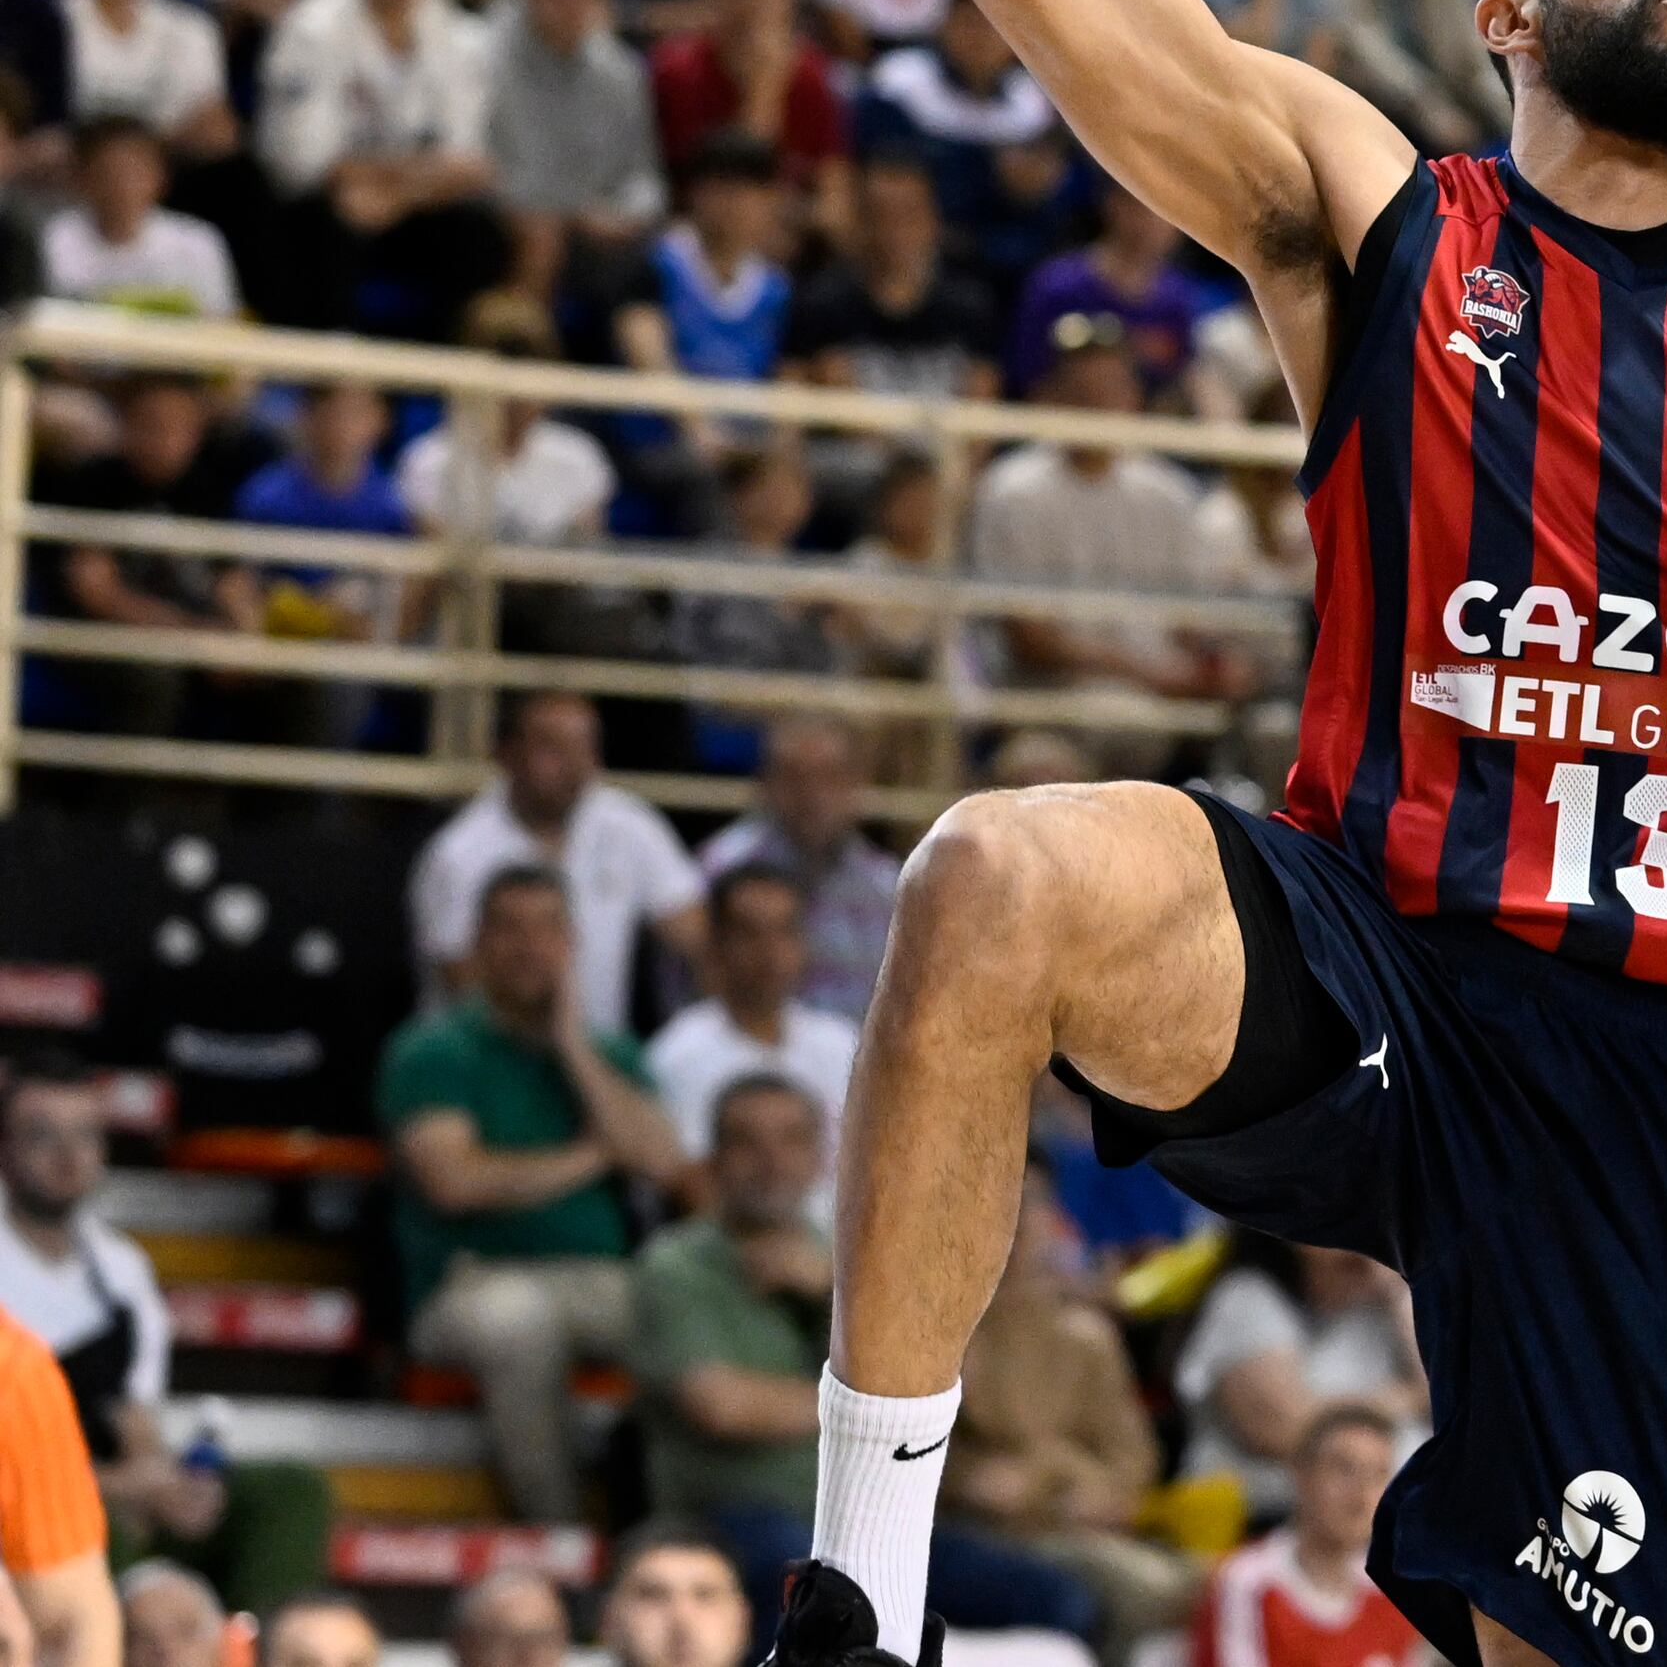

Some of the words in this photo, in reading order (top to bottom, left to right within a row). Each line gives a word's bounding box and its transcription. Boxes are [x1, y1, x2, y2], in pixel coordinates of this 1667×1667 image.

[1480, 663, 1497, 676] BK
[1416, 672, 1438, 684] ETL
[1414, 685, 1453, 696] GLOBAL
[1499, 676, 1615, 744] ETL
[1515, 1535, 1655, 1654] AMUTIO
